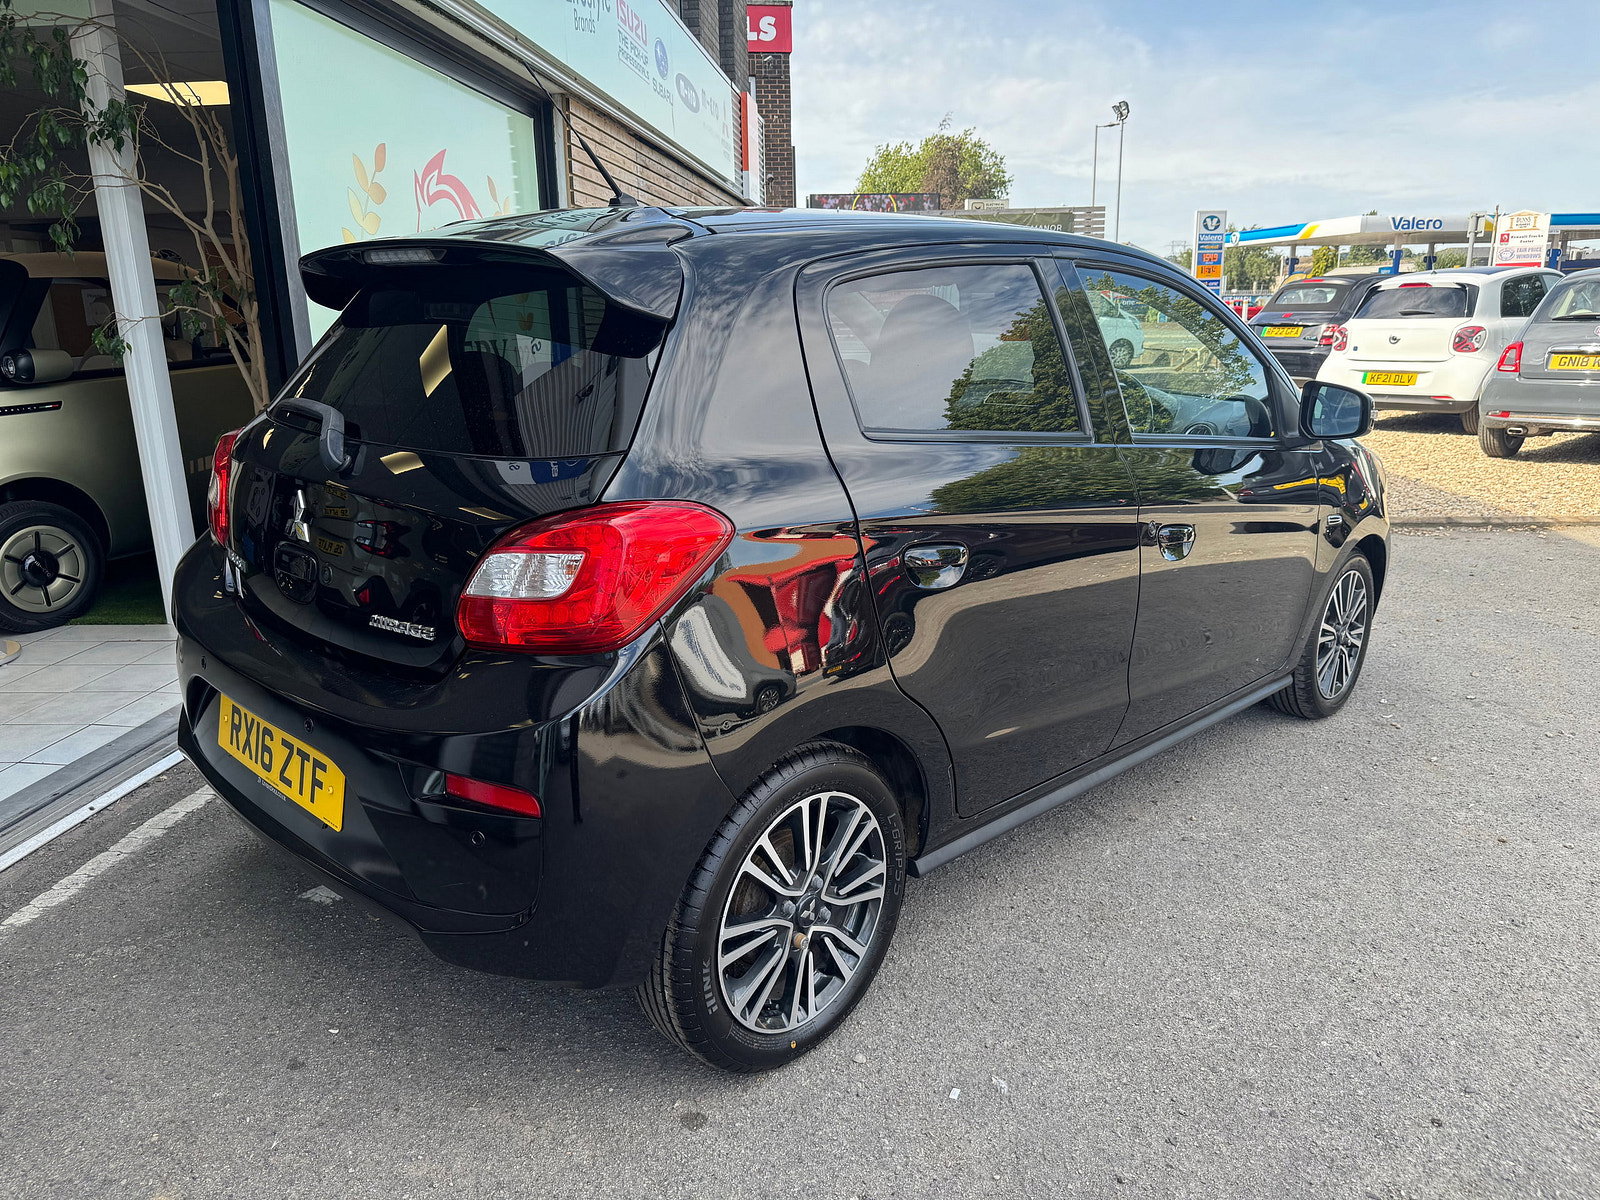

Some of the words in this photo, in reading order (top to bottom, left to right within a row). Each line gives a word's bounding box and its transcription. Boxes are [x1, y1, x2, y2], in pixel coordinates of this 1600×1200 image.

[573, 8, 596, 33] Brands
[616, 0, 648, 46] ISUZU
[1391, 216, 1443, 230] Valero
[1558, 356, 1590, 367] GN18
[1370, 374, 1392, 383] KF21
[1393, 374, 1414, 384] DLV
[368, 613, 436, 642] MIRAGE
[229, 703, 275, 773] RX16
[278, 737, 328, 805] ZTF
